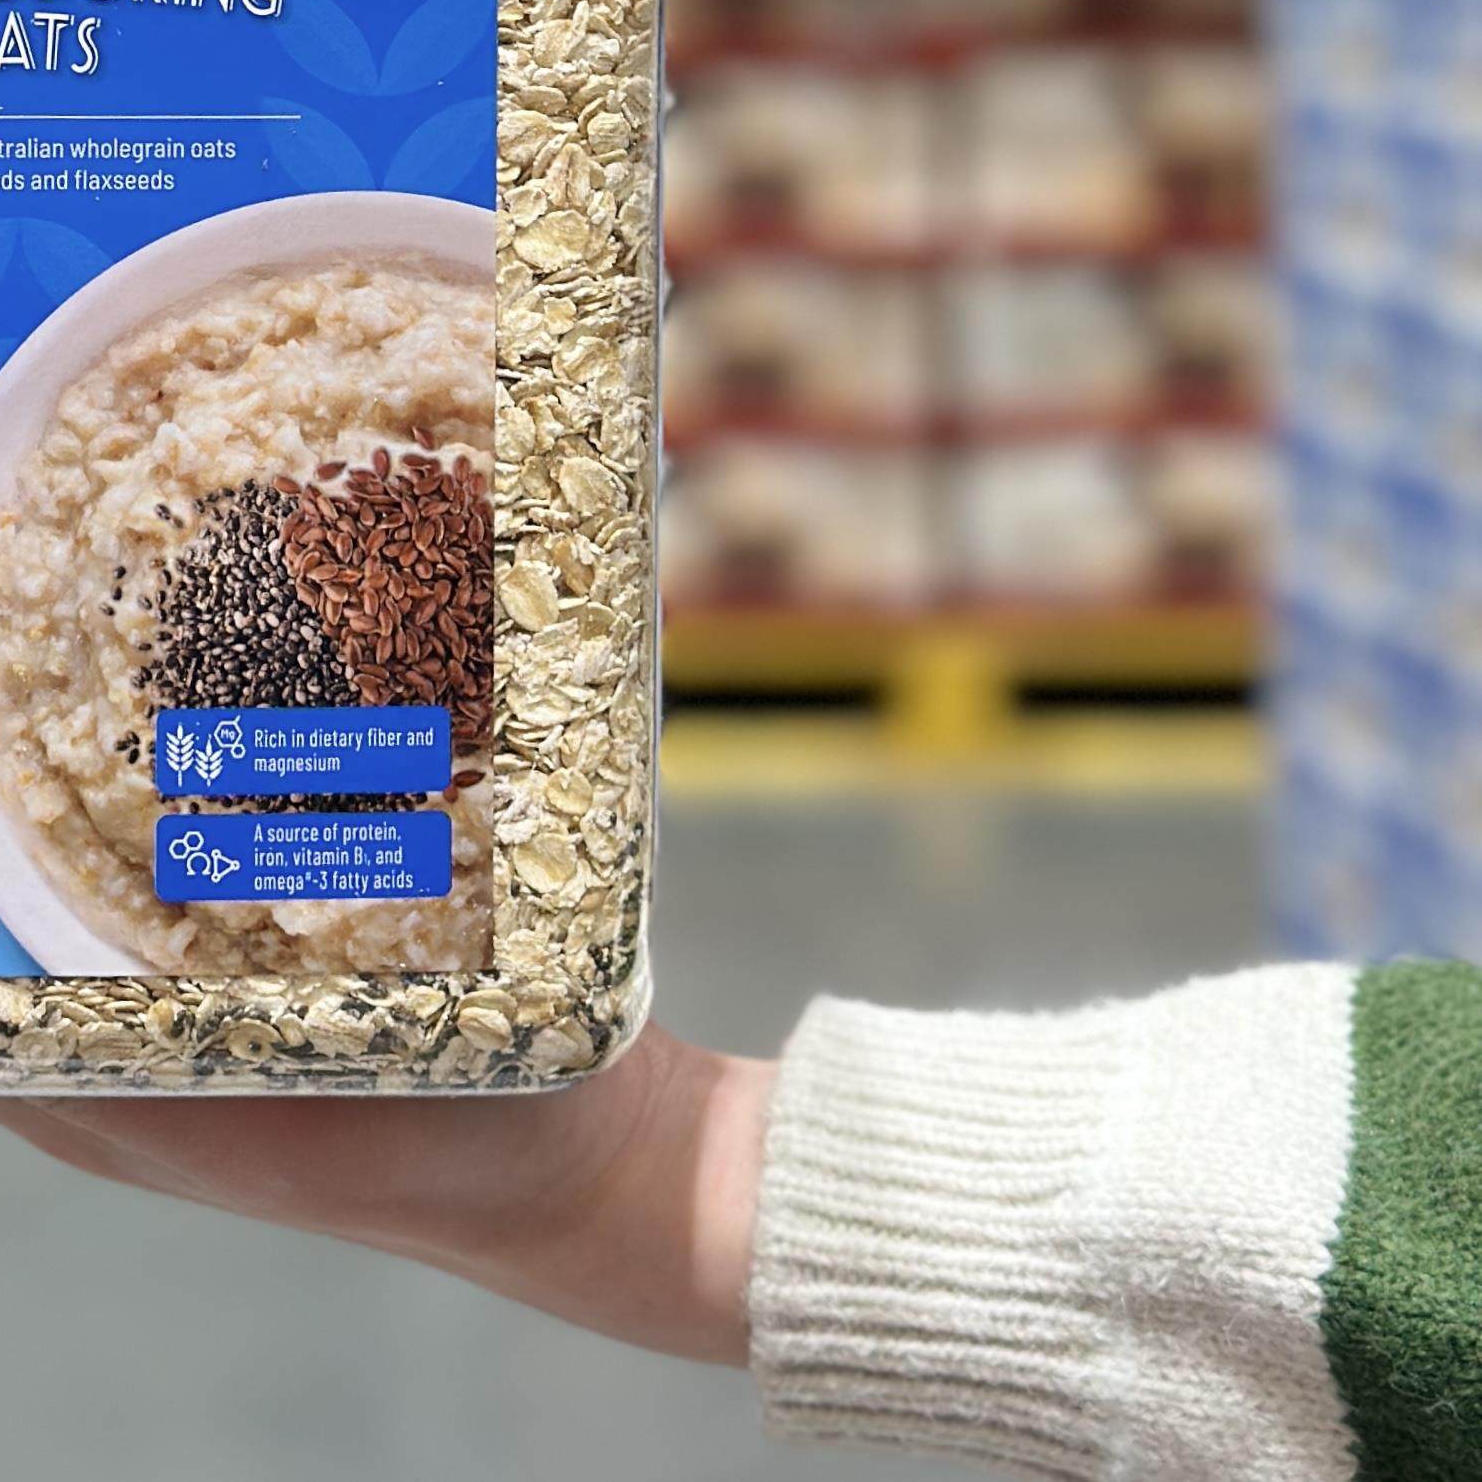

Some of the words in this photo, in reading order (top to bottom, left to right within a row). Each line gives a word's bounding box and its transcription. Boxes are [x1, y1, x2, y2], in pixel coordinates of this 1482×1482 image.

[69, 137, 185, 164] wholegrain
[190, 140, 236, 160] oats
[30, 169, 69, 191] and
[74, 169, 175, 191] flaxseeds
[254, 729, 287, 748] Rich
[292, 729, 304, 747] in
[309, 728, 362, 751] dietary
[368, 728, 402, 747] fiber
[407, 728, 434, 746] and
[254, 755, 341, 777] magnesium
[254, 823, 263, 842] A
[267, 826, 319, 843] source
[323, 822, 338, 841] of
[254, 847, 289, 867] iron,
[293, 847, 349, 866] vitamin
[375, 846, 403, 865] and
[332, 870, 369, 895] fatty
[373, 869, 413, 890] acids
